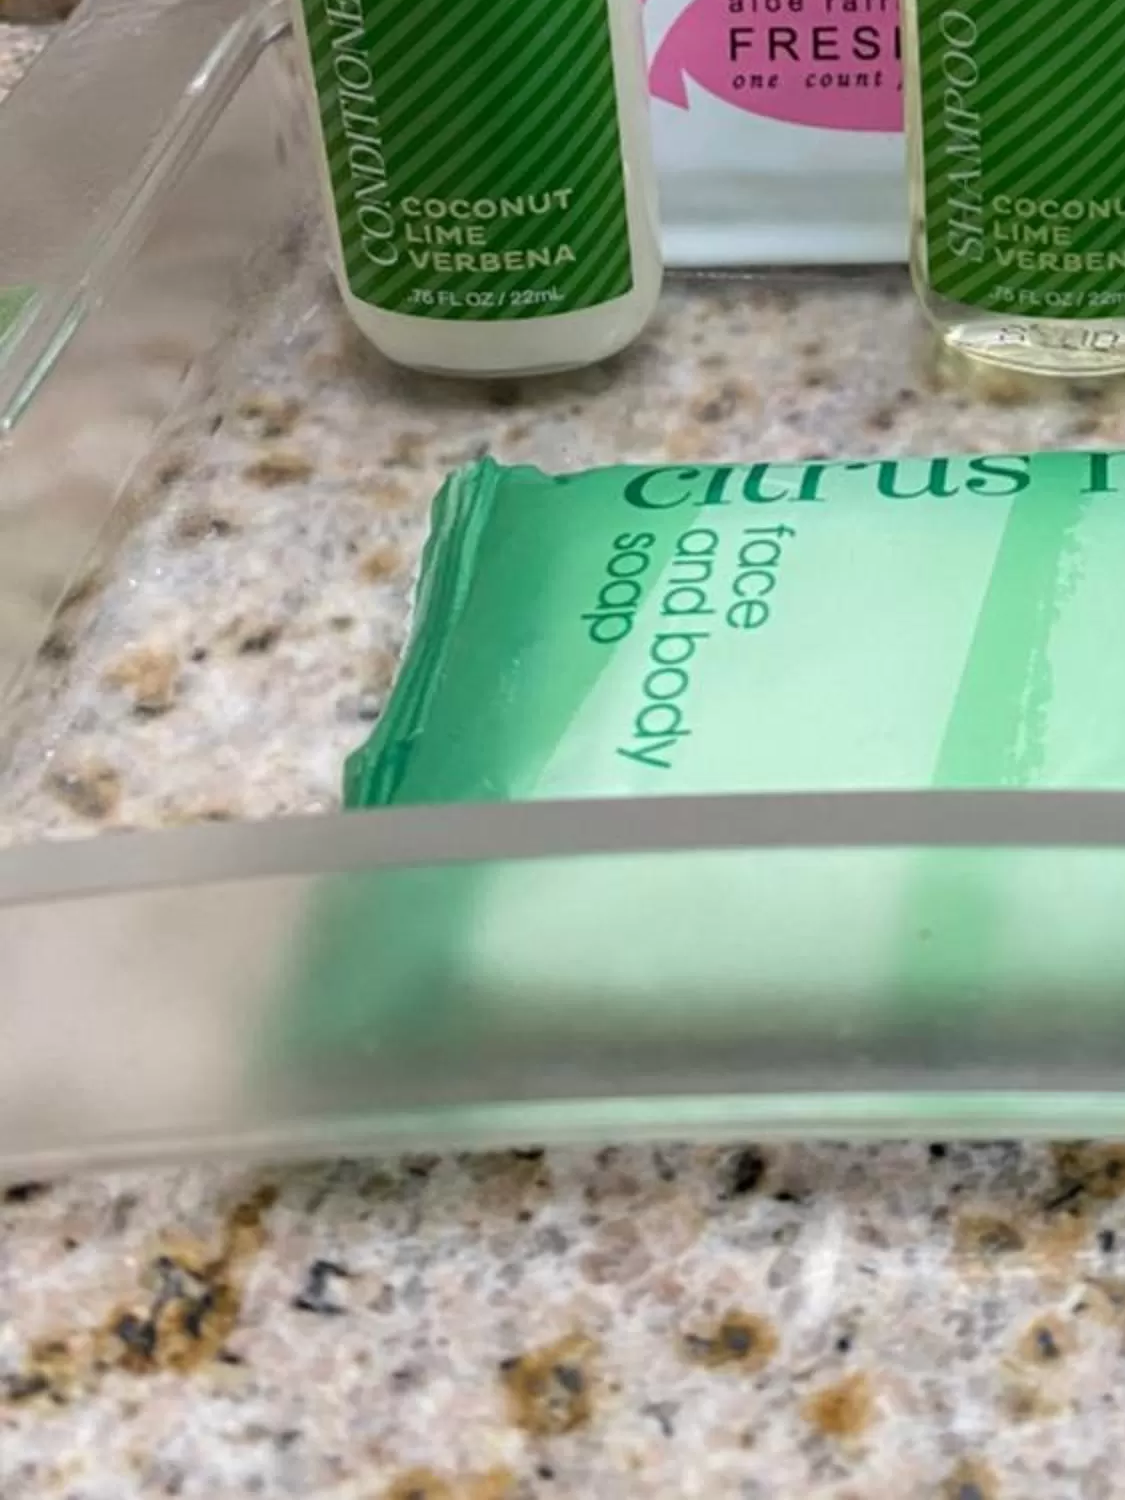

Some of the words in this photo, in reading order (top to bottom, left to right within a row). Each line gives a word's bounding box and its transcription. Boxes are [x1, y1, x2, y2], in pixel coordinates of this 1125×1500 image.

[731, 72, 780, 91] one
[804, 70, 884, 89] count
[938, 7, 985, 264] SHAMPOO
[400, 187, 575, 221] COCONUT
[404, 222, 487, 247] LIME
[992, 218, 1074, 247] LIME
[407, 243, 577, 274] VERBENA
[438, 290, 463, 307] FL
[465, 291, 495, 307] OZ
[1018, 290, 1042, 306] FL
[1044, 291, 1074, 307] OZ
[623, 453, 1033, 510] citrus
[580, 531, 656, 645] soap
[659, 527, 720, 617] and
[725, 523, 796, 630] face
[615, 631, 711, 769] body
